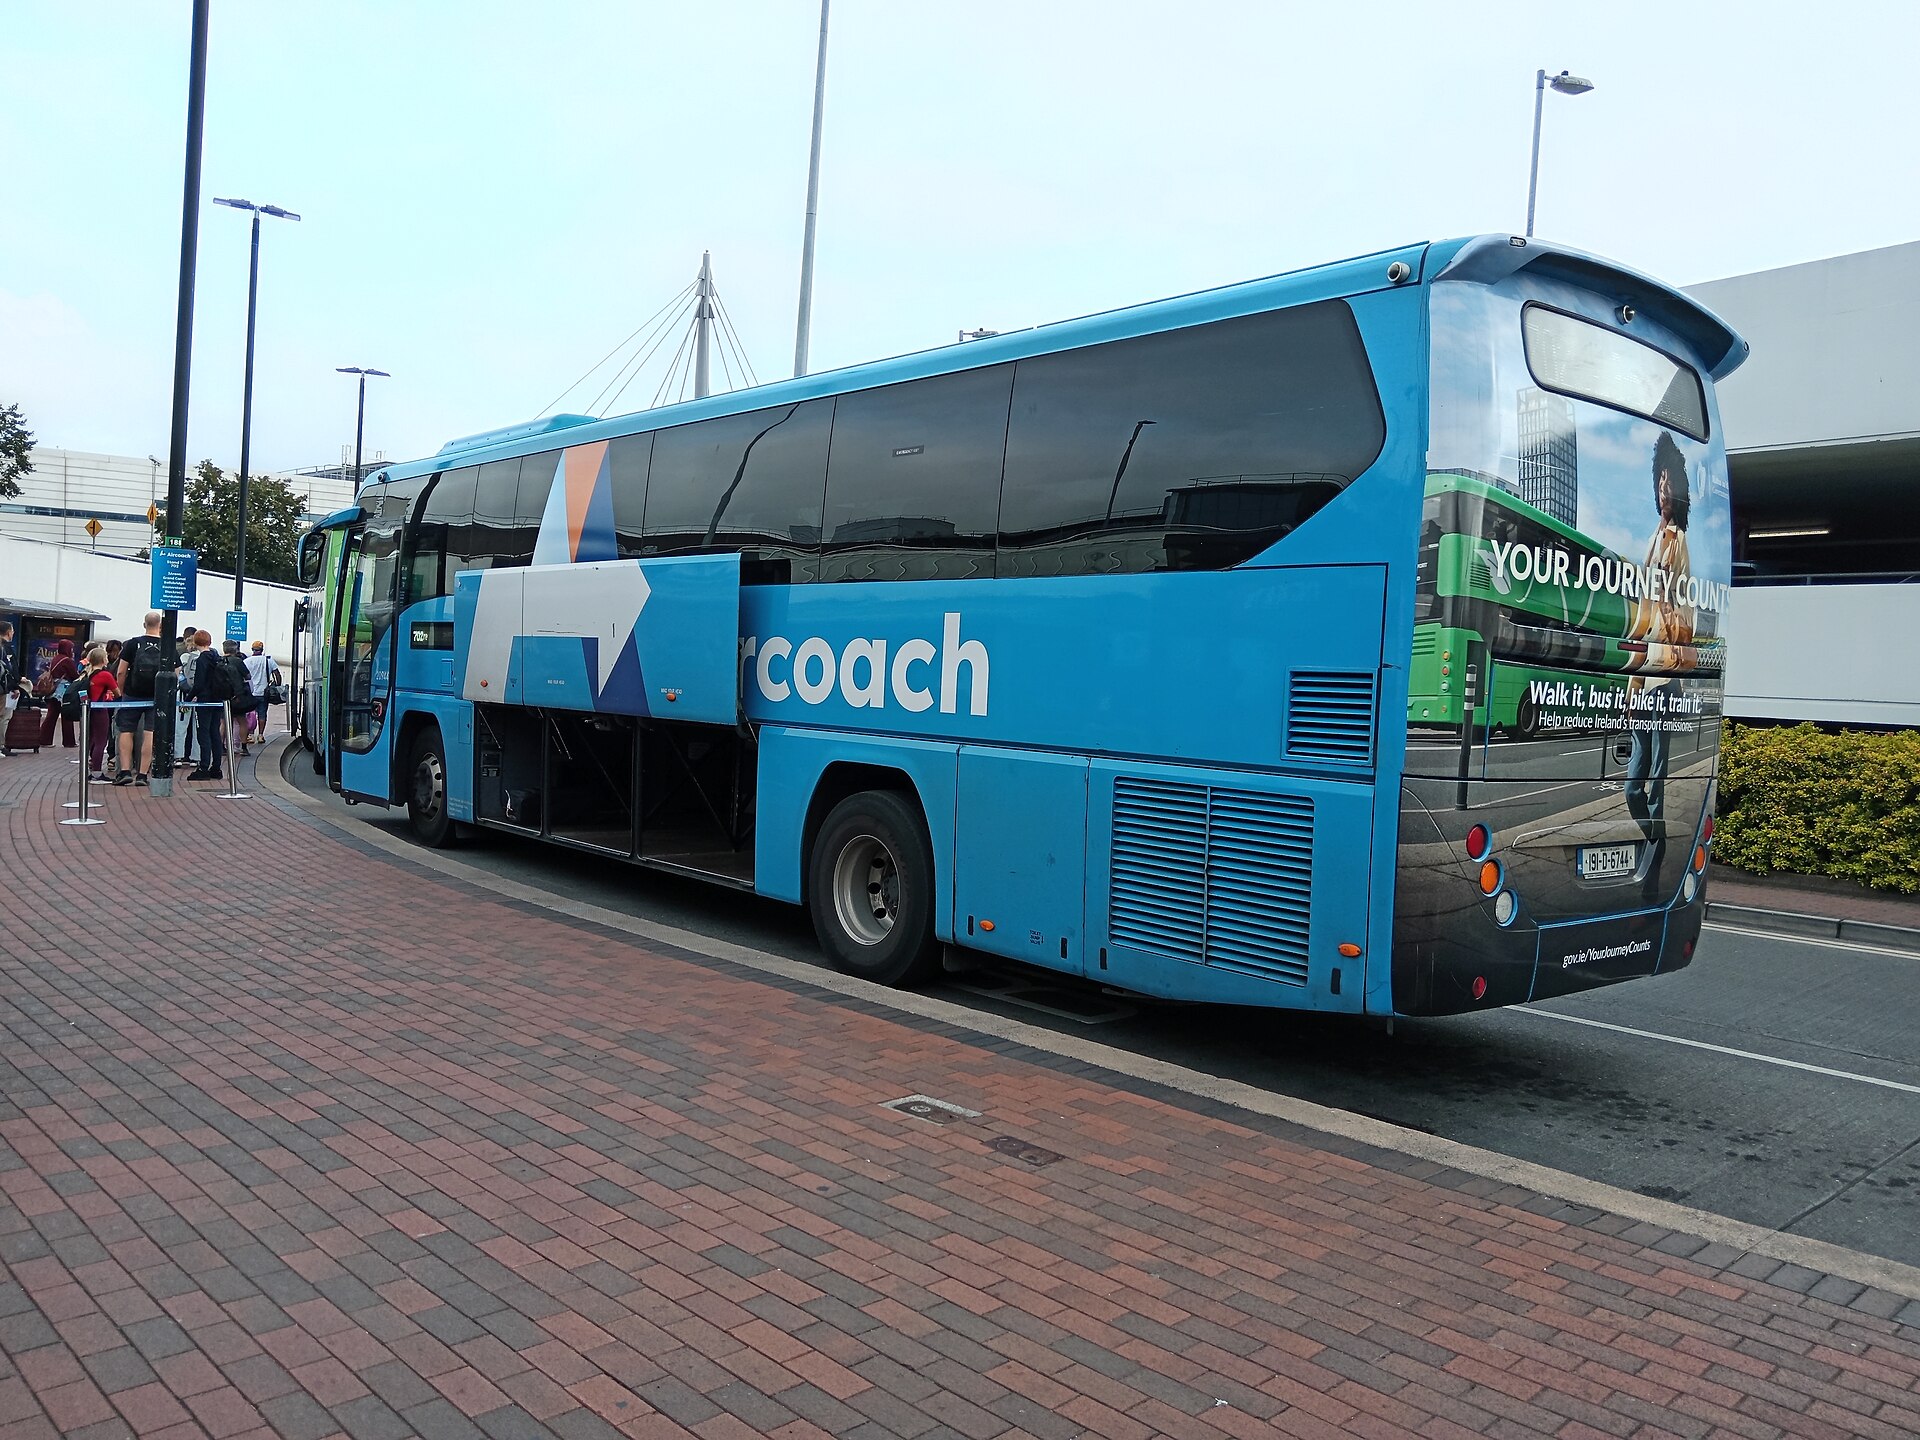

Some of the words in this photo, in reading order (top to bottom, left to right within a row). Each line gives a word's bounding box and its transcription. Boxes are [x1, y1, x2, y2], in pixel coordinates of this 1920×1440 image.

[1490, 539, 1570, 588] YOUR
[1573, 556, 1674, 603] JOURNEY
[1530, 680, 1569, 707] Walk
[1571, 683, 1586, 711] it,
[1588, 684, 1613, 709] bus
[1613, 687, 1627, 713] it,
[1629, 688, 1654, 712] bike
[1655, 690, 1667, 716] it,
[1668, 692, 1692, 714] train
[1538, 711, 1562, 730] Help
[1563, 712, 1594, 728] reduce
[1629, 717, 1662, 733] transport
[1588, 850, 1629, 871] 191-D-6744
[1562, 939, 1651, 969] gov.ie/YourJourneyCounts
